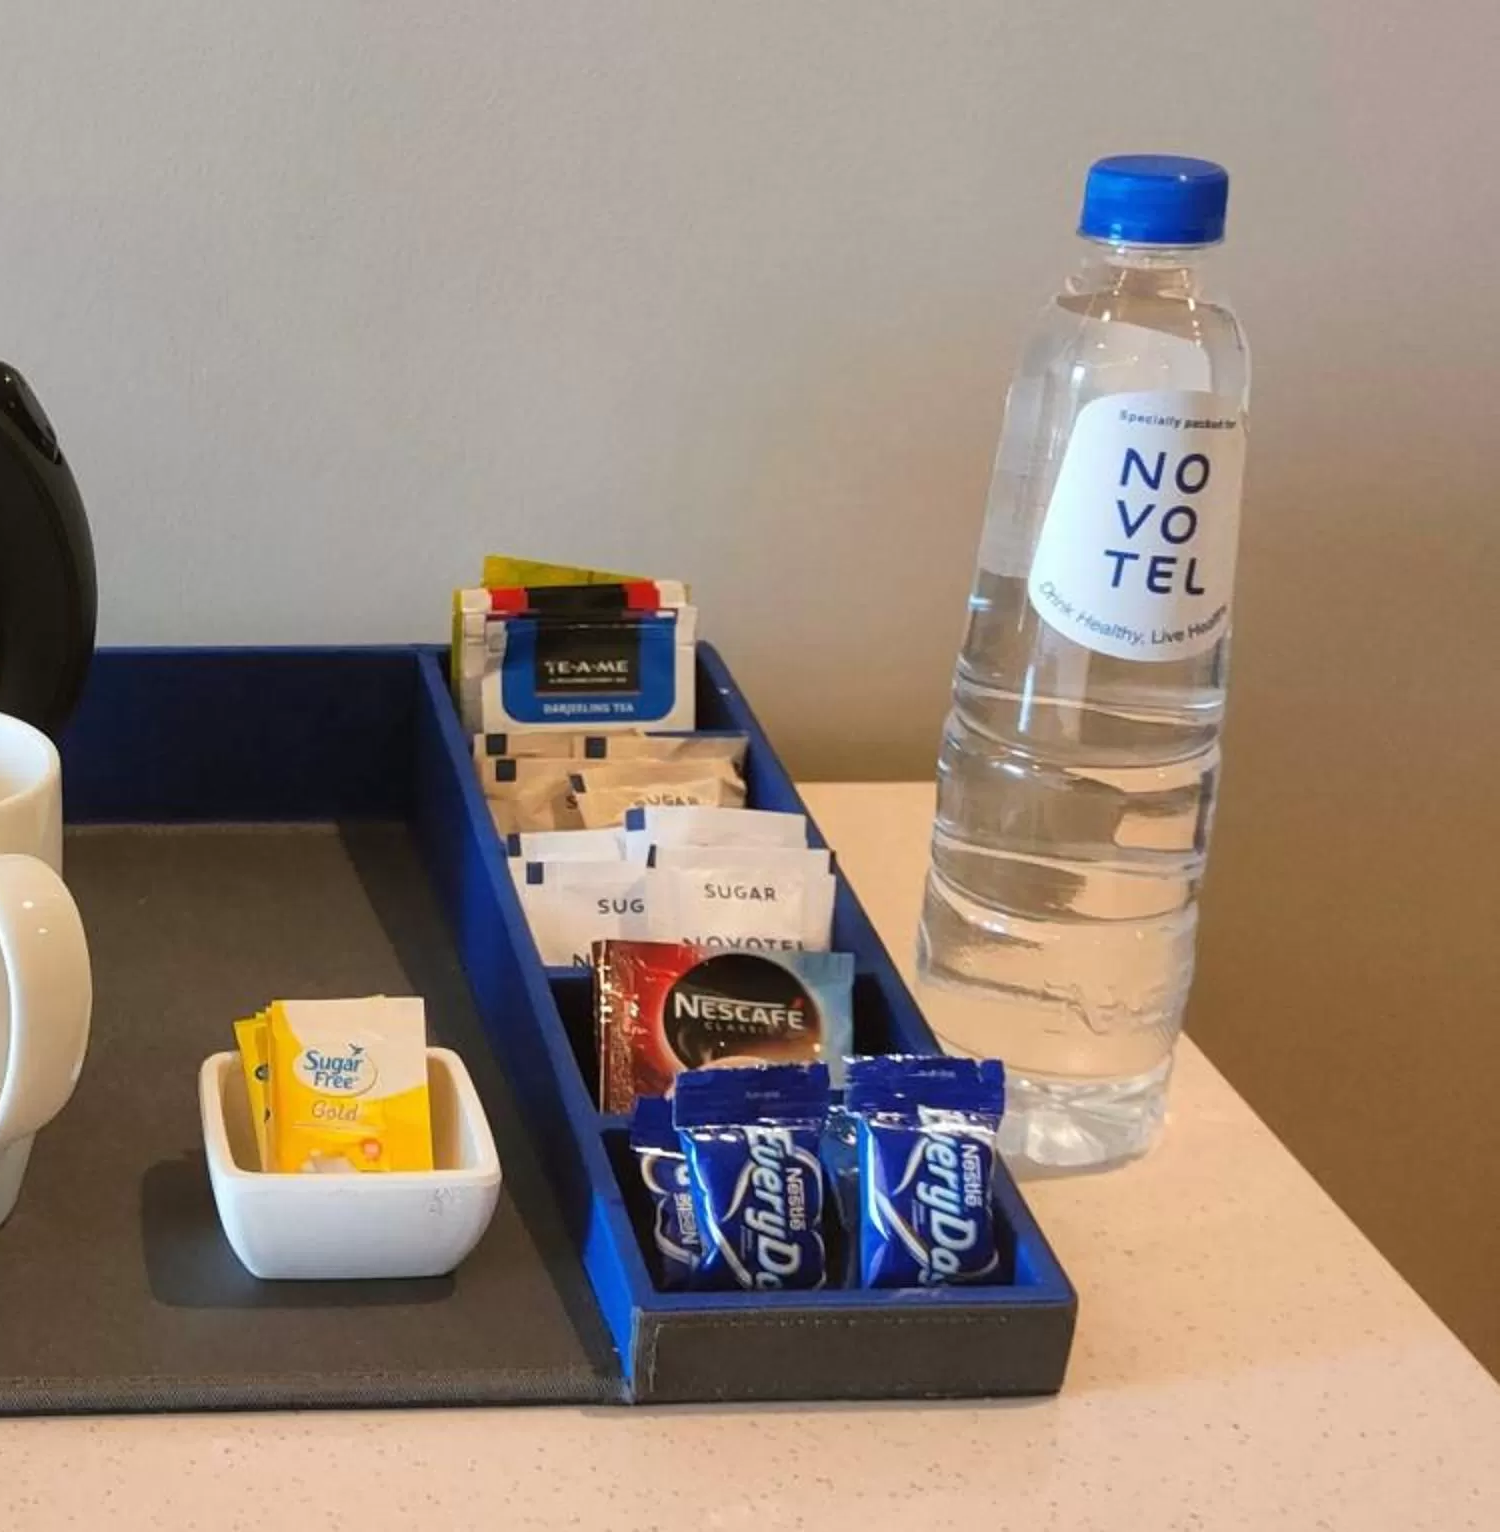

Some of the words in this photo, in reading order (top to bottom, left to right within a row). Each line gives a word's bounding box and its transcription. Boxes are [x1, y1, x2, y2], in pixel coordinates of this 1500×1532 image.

[1119, 409, 1182, 429] Specially
[1119, 447, 1210, 495] NO
[1115, 499, 1198, 545] VO
[1103, 549, 1206, 596] TEL
[1151, 627, 1185, 646] Live
[612, 702, 635, 714] TEA
[704, 883, 777, 902] SUGAR
[597, 898, 645, 915] SUG
[303, 1049, 365, 1076] Sugar
[313, 1070, 357, 1090] Free
[311, 1100, 359, 1122] Gold
[743, 1125, 802, 1289] EveryDa
